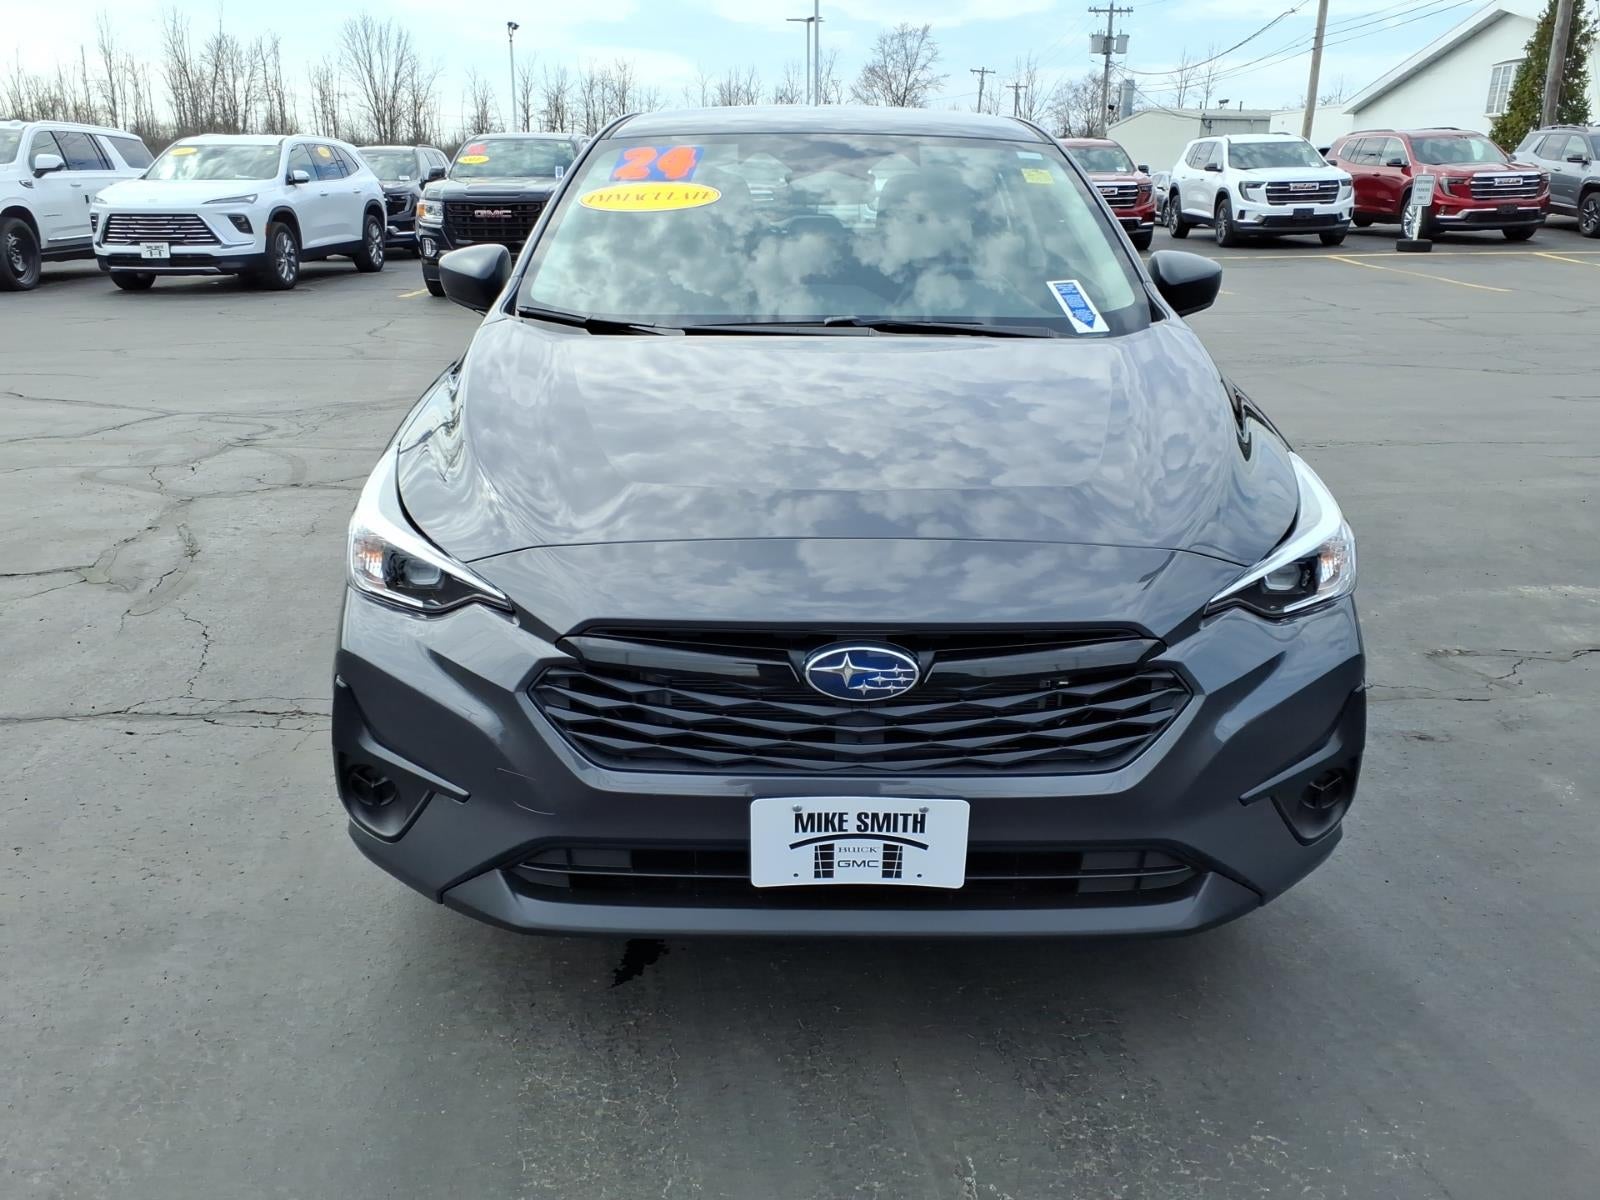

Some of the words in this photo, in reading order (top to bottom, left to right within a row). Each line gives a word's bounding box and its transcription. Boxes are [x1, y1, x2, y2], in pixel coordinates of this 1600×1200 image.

[614, 146, 696, 180] 24
[474, 209, 512, 218] GMC
[795, 811, 849, 834] MIKE
[856, 811, 927, 834] SMITH
[838, 846, 878, 854] BUICK
[837, 859, 880, 868] GMC
